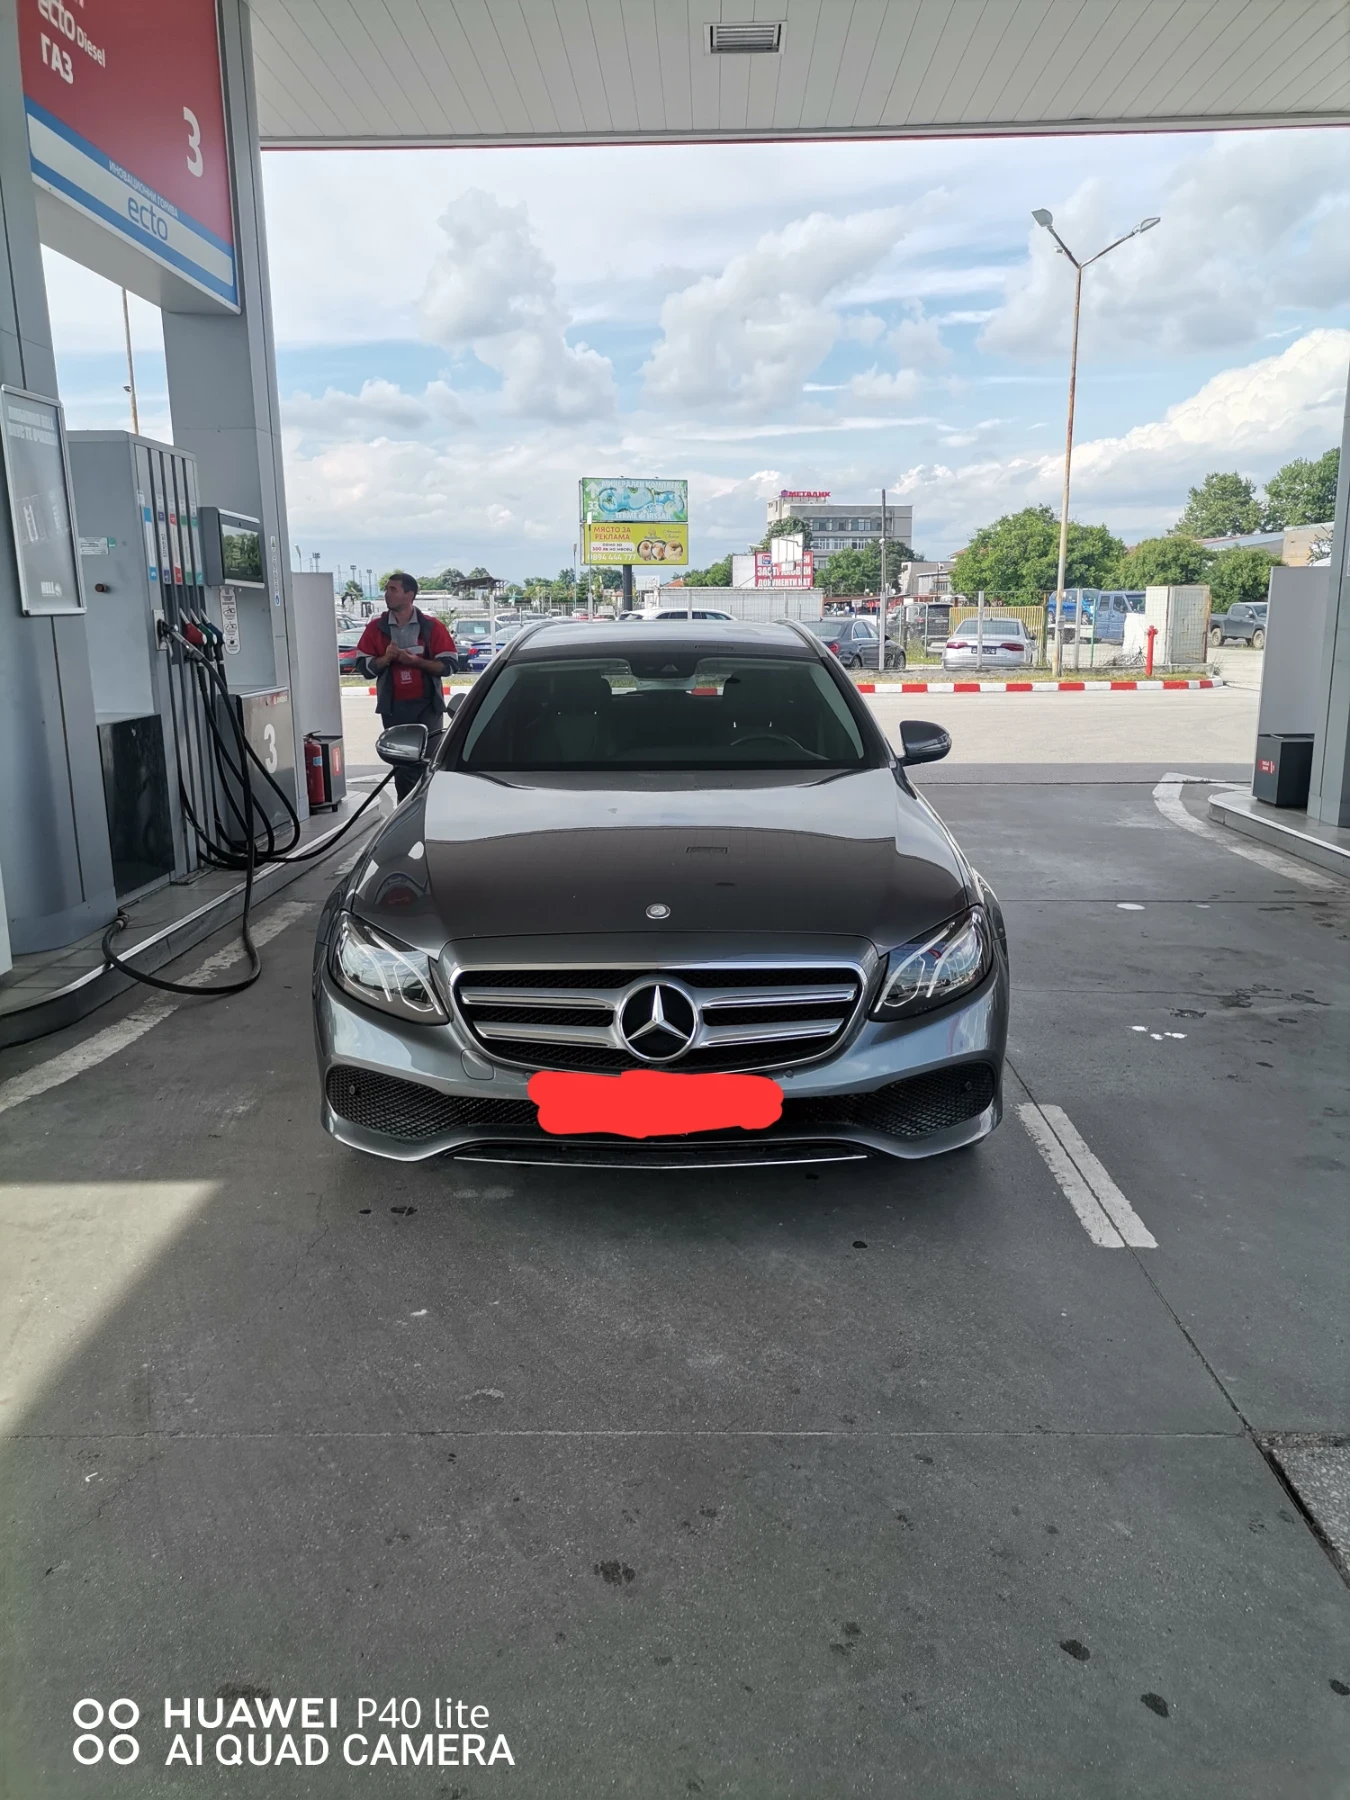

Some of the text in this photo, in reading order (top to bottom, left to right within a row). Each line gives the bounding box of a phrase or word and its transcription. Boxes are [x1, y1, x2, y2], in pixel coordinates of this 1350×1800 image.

[41, 32, 74, 84] ГАЗ
[76, 25, 105, 68] Diesel
[183, 106, 204, 177] 3
[127, 196, 168, 241] ecto
[263, 723, 278, 774] 3
